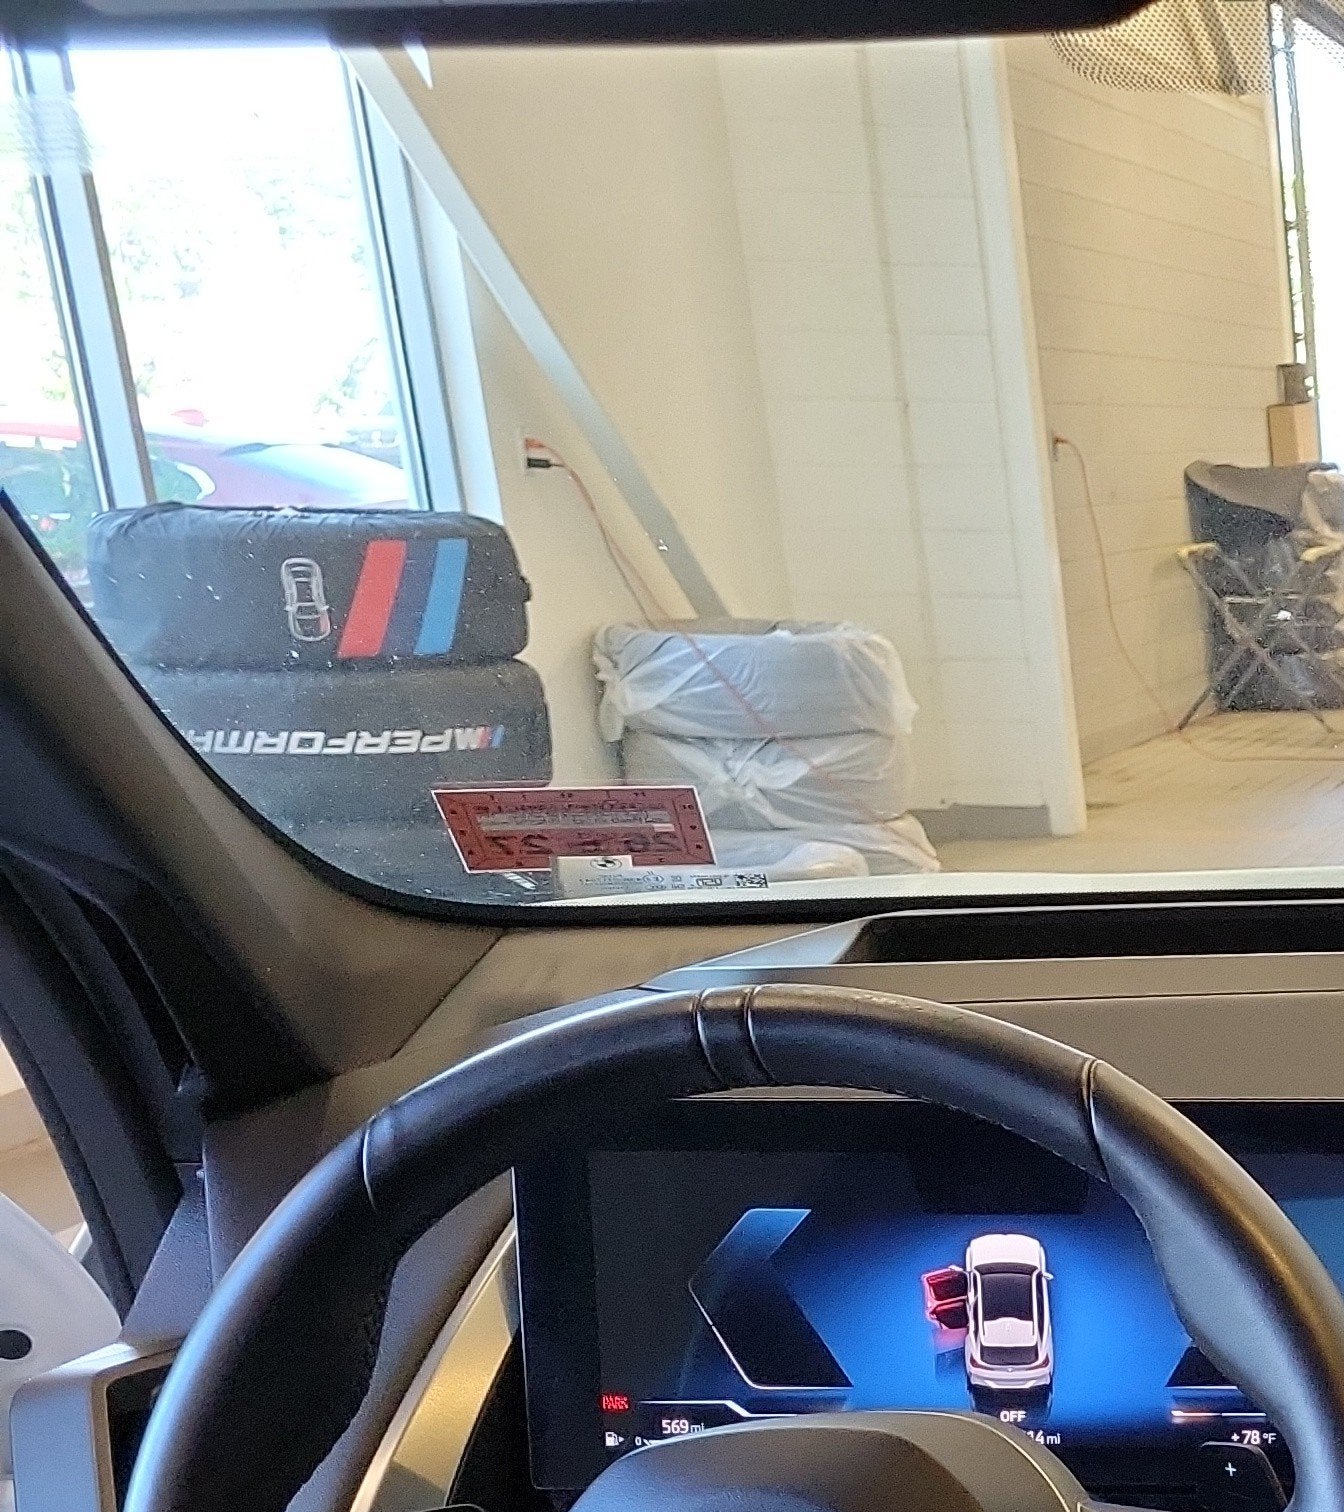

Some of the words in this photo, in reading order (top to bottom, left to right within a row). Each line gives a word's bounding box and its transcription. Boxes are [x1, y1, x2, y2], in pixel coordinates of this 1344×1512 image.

[602, 1395, 629, 1410] PARK
[1000, 1410, 1027, 1423] OFF
[661, 1418, 689, 1434] 569
[690, 1422, 705, 1433] mi
[1046, 1433, 1061, 1445] mi
